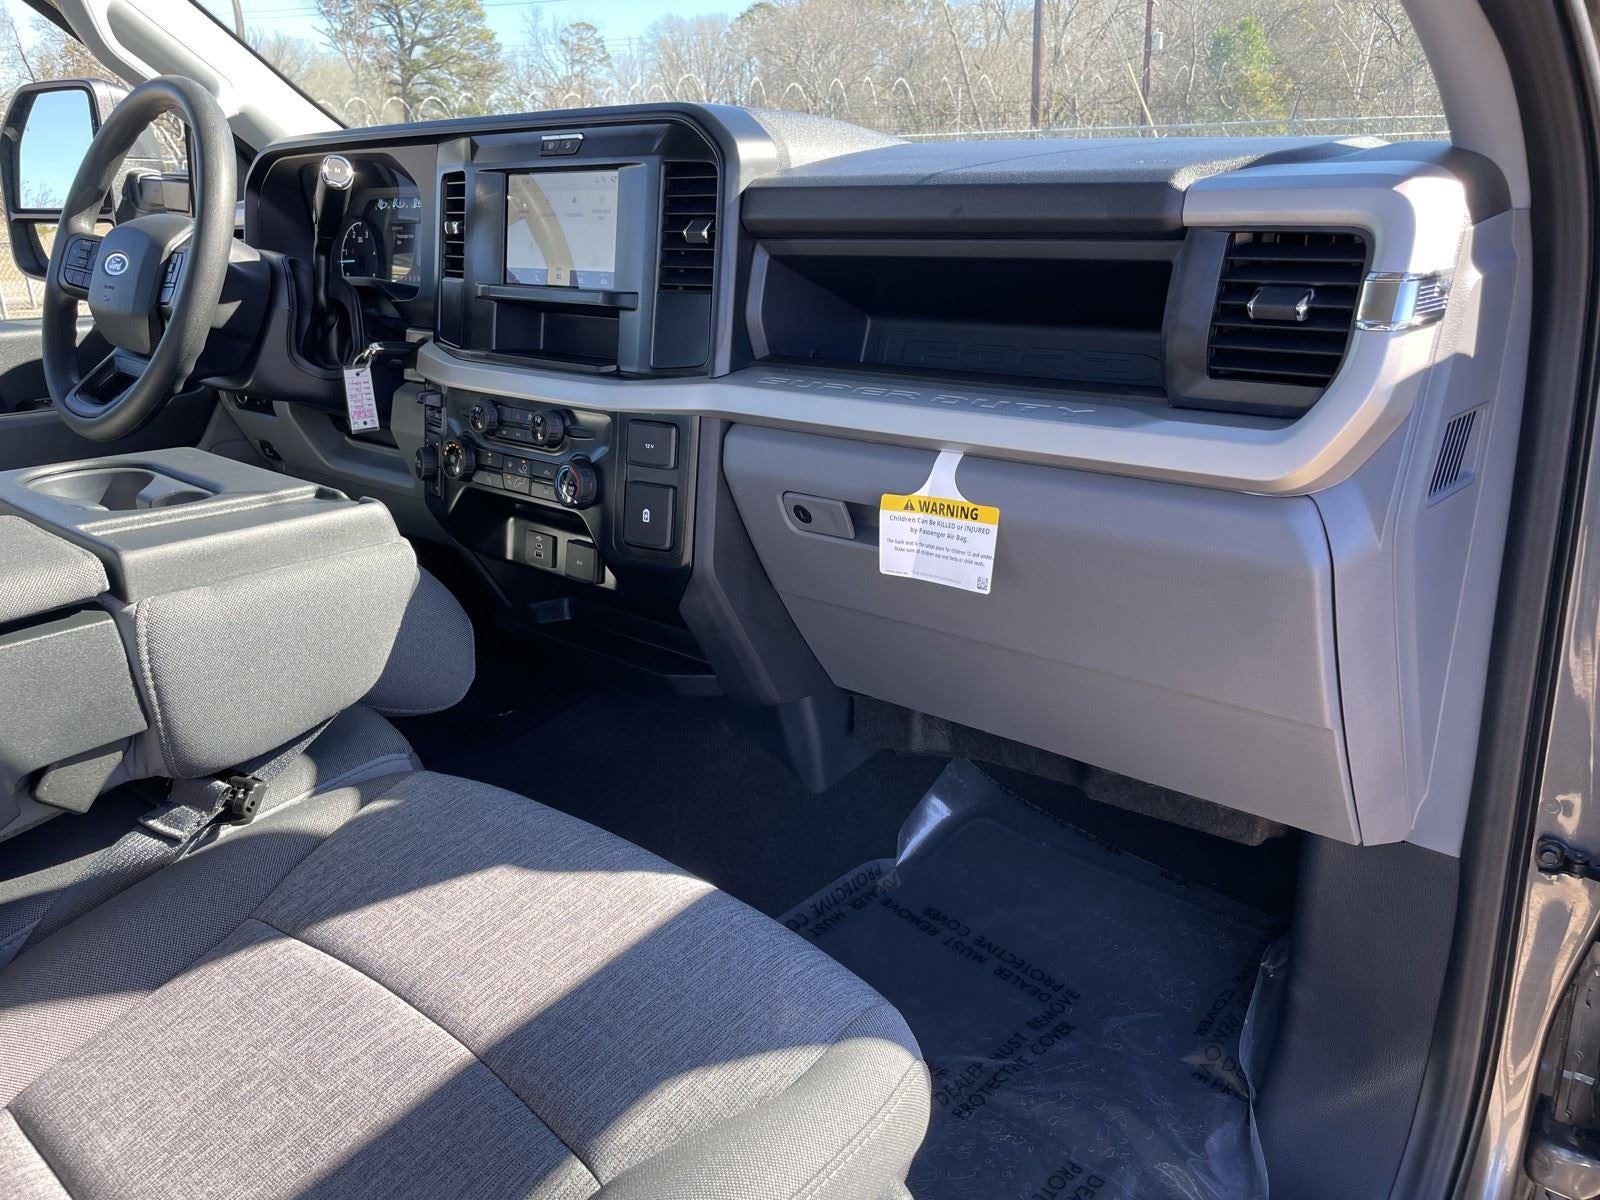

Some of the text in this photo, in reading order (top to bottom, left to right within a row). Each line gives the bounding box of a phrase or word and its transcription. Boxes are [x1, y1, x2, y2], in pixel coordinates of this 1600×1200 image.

[757, 376, 1096, 417] SUPER DUTY
[889, 514, 916, 523] Children
[917, 517, 928, 525] Can
[937, 521, 956, 530] KILLED
[964, 525, 990, 535] INJURED
[918, 500, 979, 521] WARNING
[919, 528, 946, 539] Passenger
[809, 863, 883, 918] PROTECTIVE
[809, 910, 847, 938] MUST
[880, 897, 1052, 1003] DEALER MUST REMOVE
[921, 906, 1065, 992] PROTECTIVE COVER
[1194, 989, 1234, 1037] COVER
[934, 1062, 986, 1107] DEALER
[989, 1032, 1029, 1060] MUST
[951, 1021, 1077, 1120] PROTECTIVE COVER
